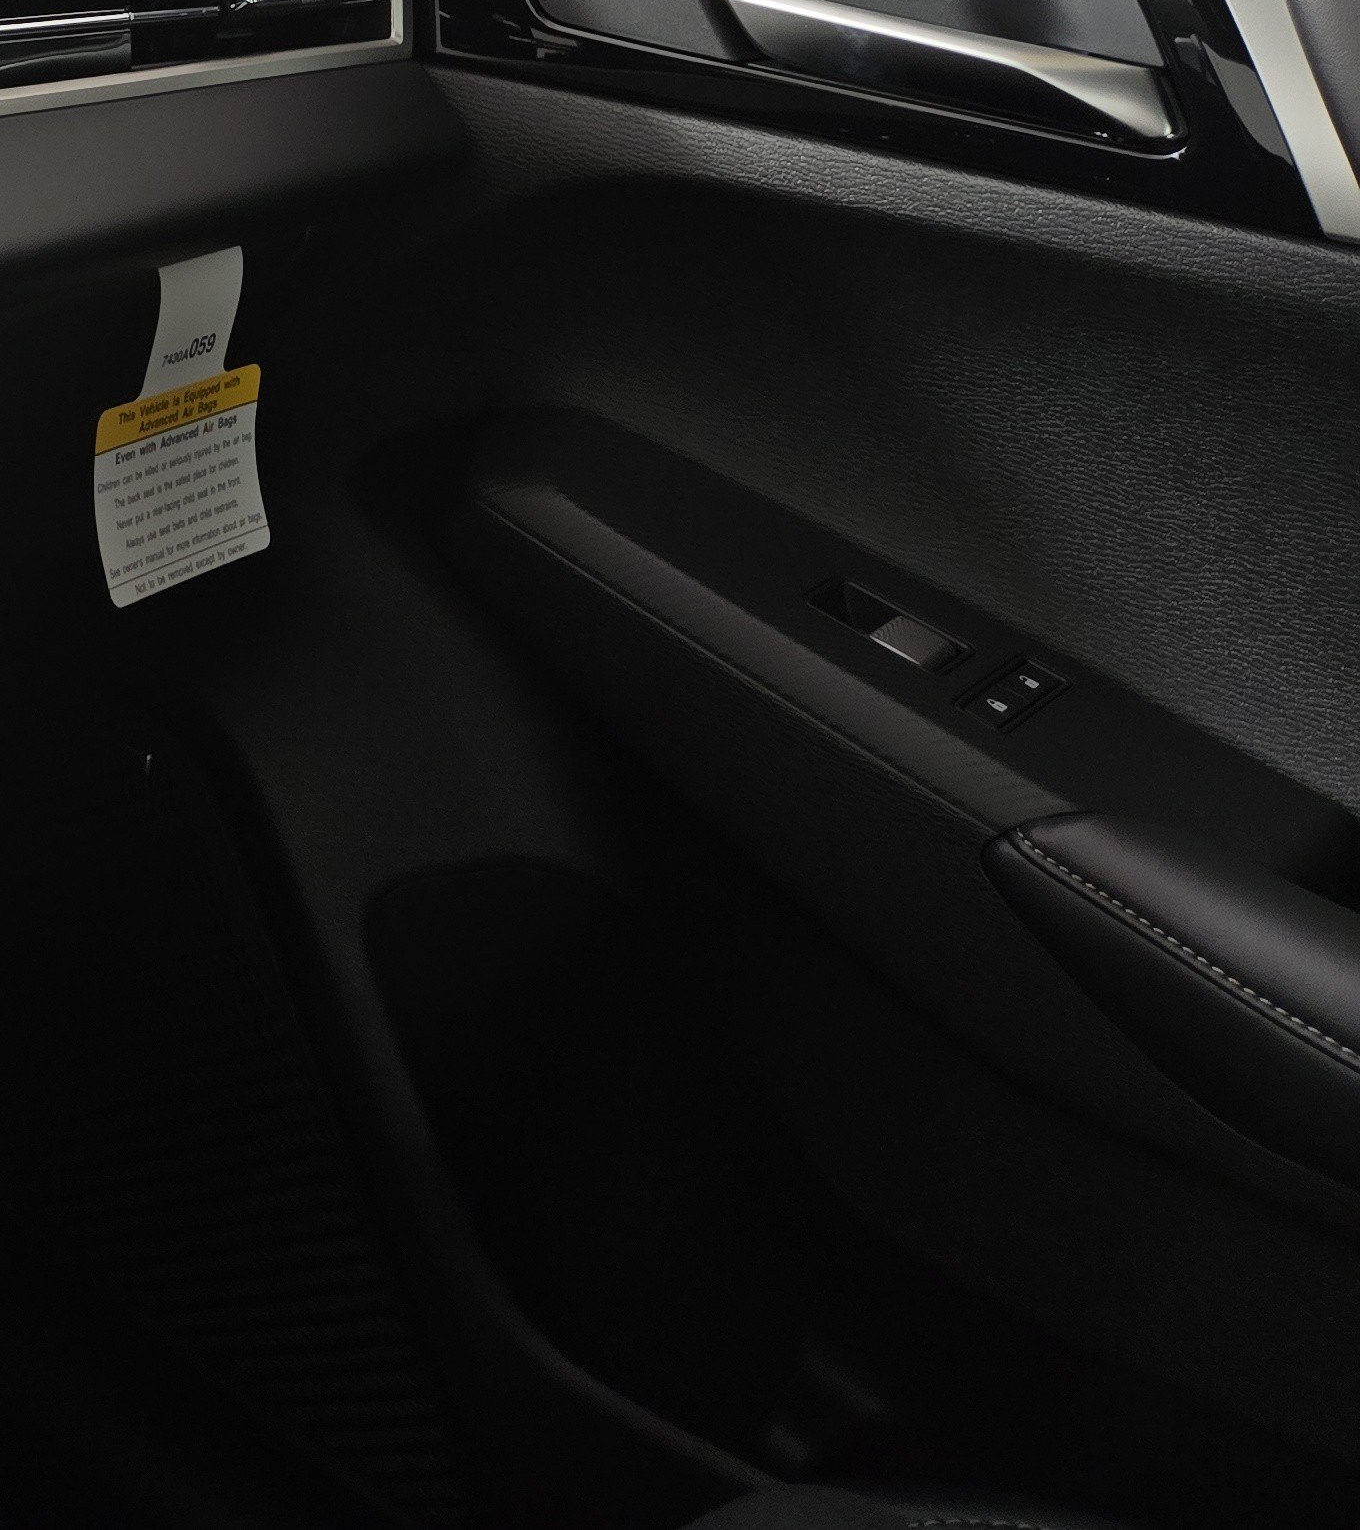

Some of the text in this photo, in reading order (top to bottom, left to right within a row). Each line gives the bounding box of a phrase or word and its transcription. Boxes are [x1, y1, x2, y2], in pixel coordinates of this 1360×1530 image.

[118, 410, 137, 426] This
[139, 398, 170, 418] Vehicle
[183, 381, 222, 405] Equipped
[223, 375, 241, 390] with
[139, 399, 219, 434] Advanced Air Bags
[114, 414, 238, 466] Even with Advanced Air Bags
